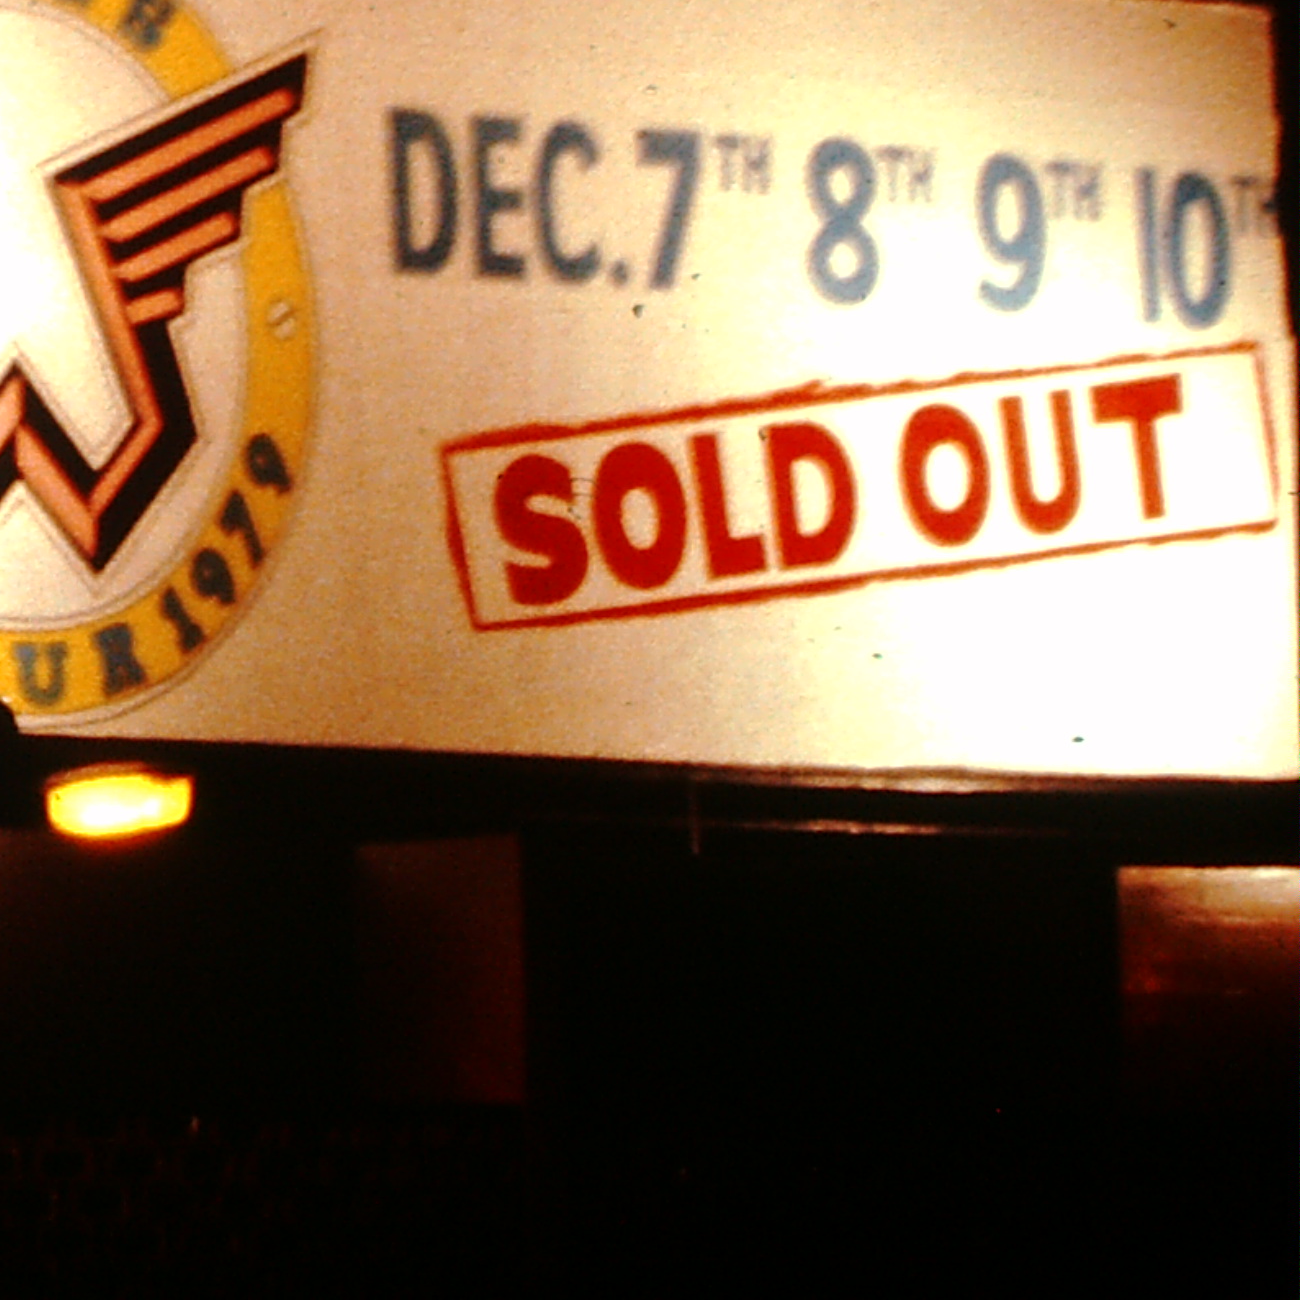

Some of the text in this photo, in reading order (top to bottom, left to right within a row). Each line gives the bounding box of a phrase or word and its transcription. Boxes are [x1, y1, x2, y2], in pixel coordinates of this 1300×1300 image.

[803, 134, 937, 306] 8TH
[978, 152, 1105, 313] 9TH
[158, 432, 294, 656] 1979
[493, 372, 1184, 609] SOLD OUT
